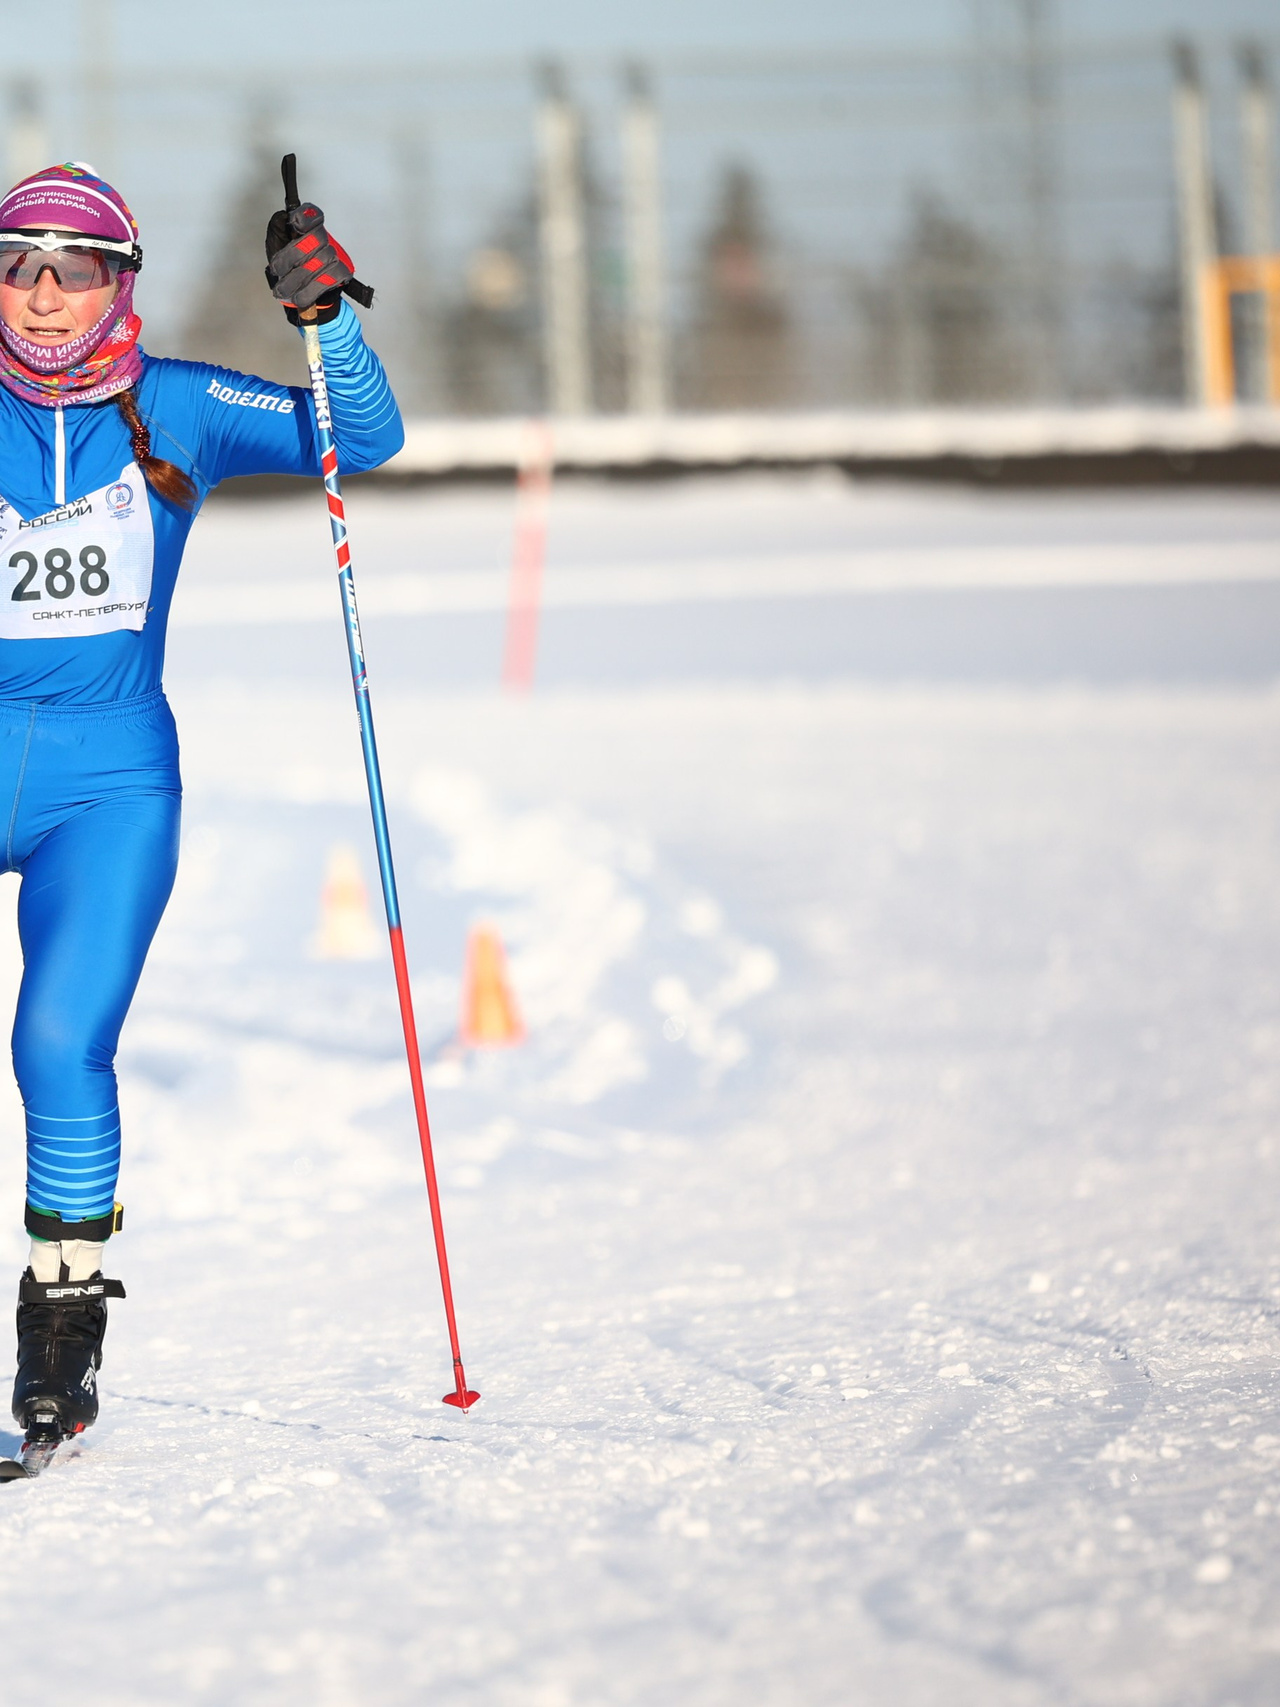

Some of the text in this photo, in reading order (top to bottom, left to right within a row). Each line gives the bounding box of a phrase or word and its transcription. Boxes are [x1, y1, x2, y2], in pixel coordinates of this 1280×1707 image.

[26, 191, 86, 203] ГАТЧИНСКИЙ
[47, 198, 101, 218] МАРАФОН
[57, 375, 132, 407] ГАТЧИНСКИЙ
[18, 504, 93, 531] РОССИИ
[8, 544, 110, 602] 288
[32, 600, 147, 621] САНКТ-ПЕТЕРБУРГ
[45, 1284, 105, 1299] SPINE
